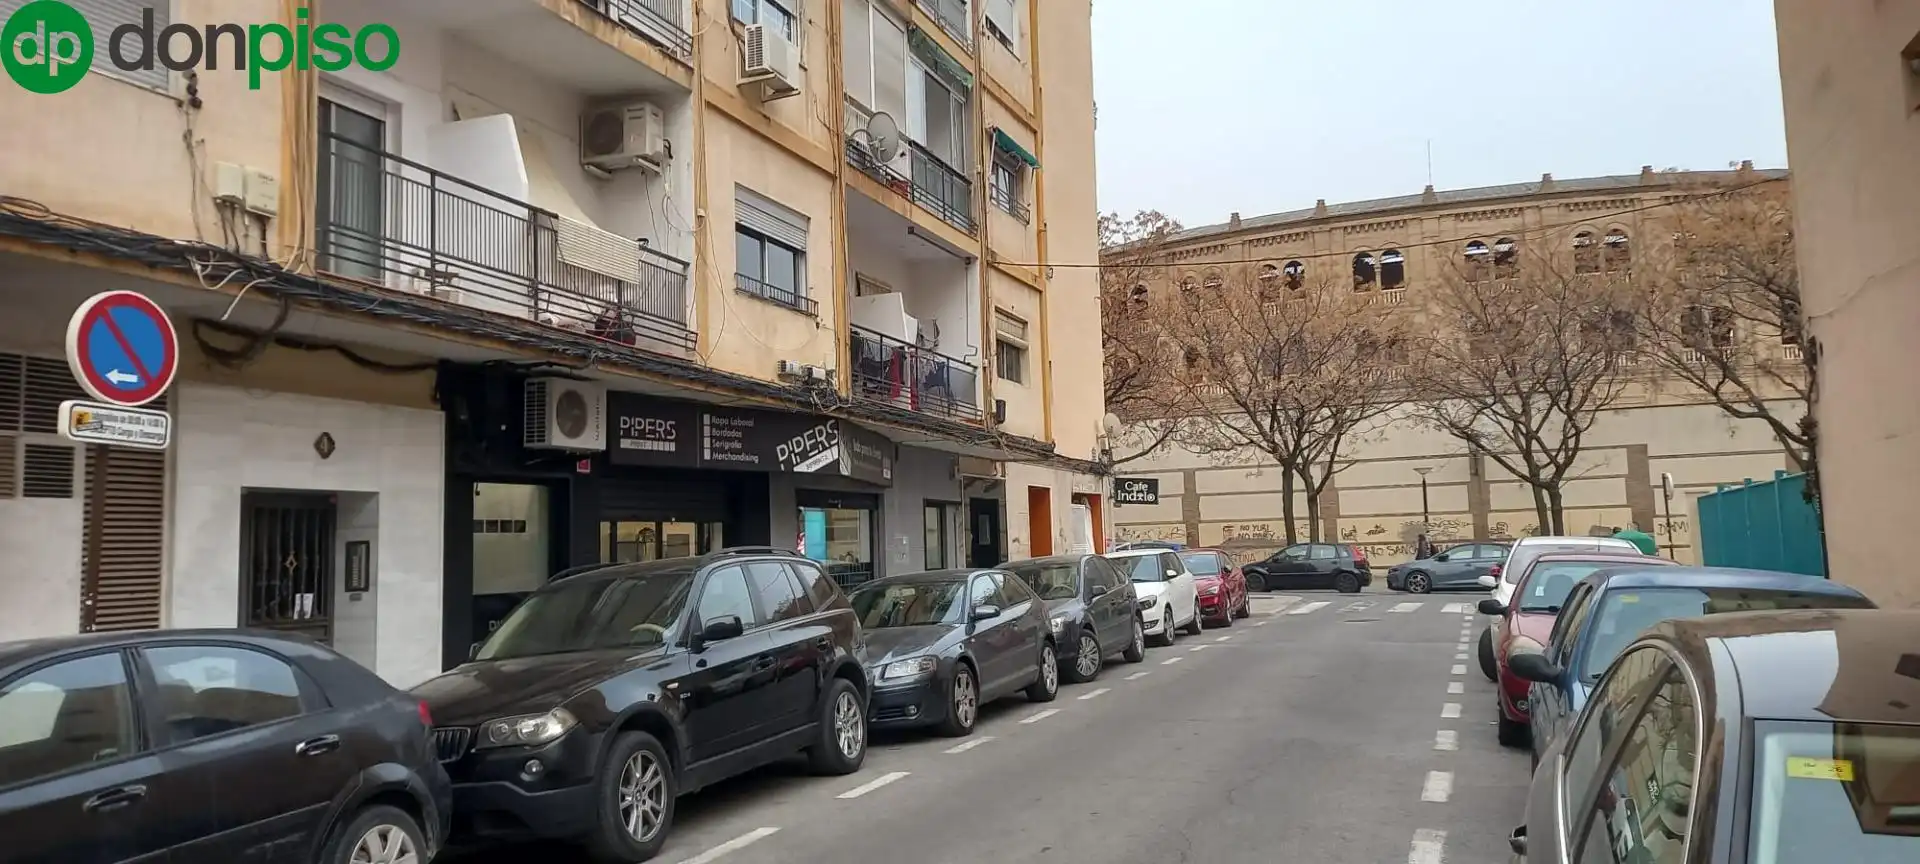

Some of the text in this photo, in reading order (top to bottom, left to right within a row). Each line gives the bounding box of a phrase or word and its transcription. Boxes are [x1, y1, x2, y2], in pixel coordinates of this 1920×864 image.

[620, 416, 676, 440] PIPERS
[711, 415, 729, 427] Ropa
[711, 427, 742, 438] Bordados
[775, 419, 839, 472] PIPERS
[711, 450, 759, 464] Merchandising
